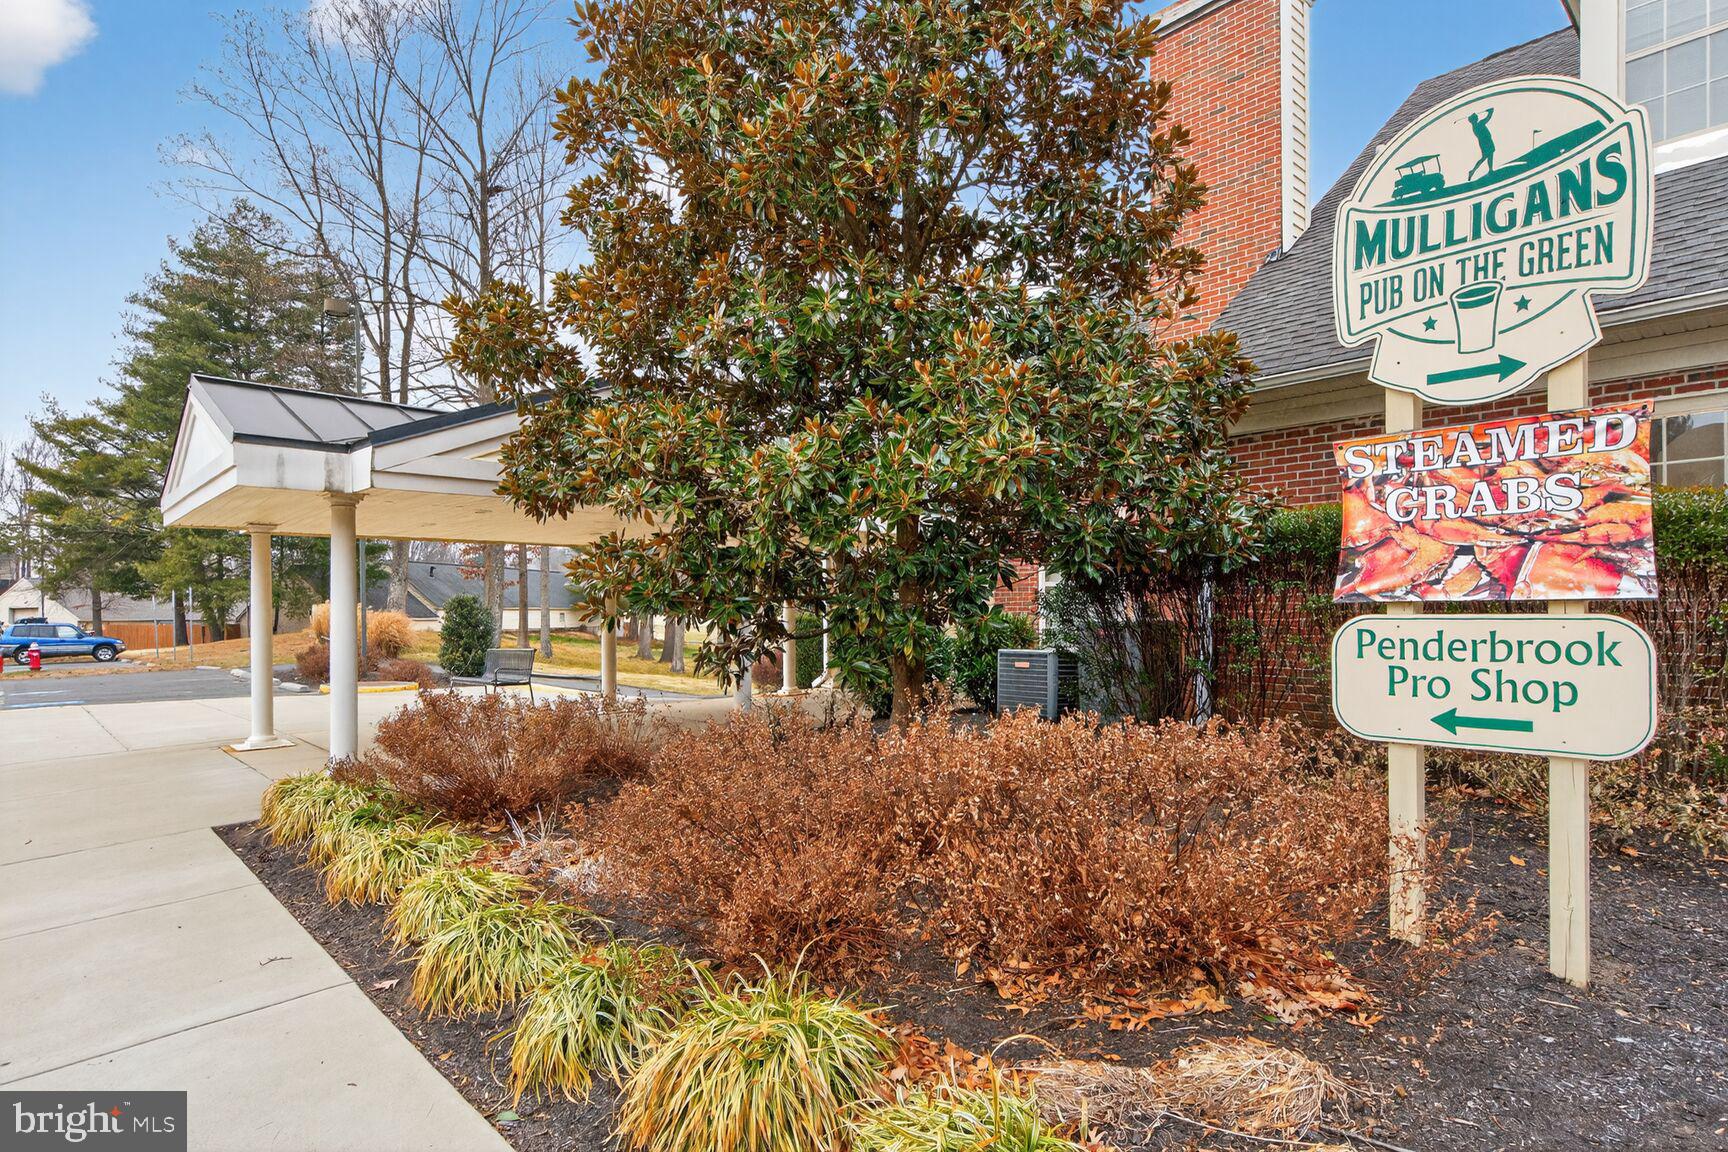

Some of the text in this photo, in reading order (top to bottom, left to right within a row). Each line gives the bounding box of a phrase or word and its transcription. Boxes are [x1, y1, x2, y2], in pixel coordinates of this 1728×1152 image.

[1352, 141, 1628, 271] MULLIGANS
[1359, 221, 1614, 320] PUB ON THE GREEN
[1343, 413, 1638, 479] STEAMED
[1385, 472, 1583, 522] CRABS
[1356, 628, 1623, 667] Penderbrook
[1388, 665, 1579, 712] Pro Shop
